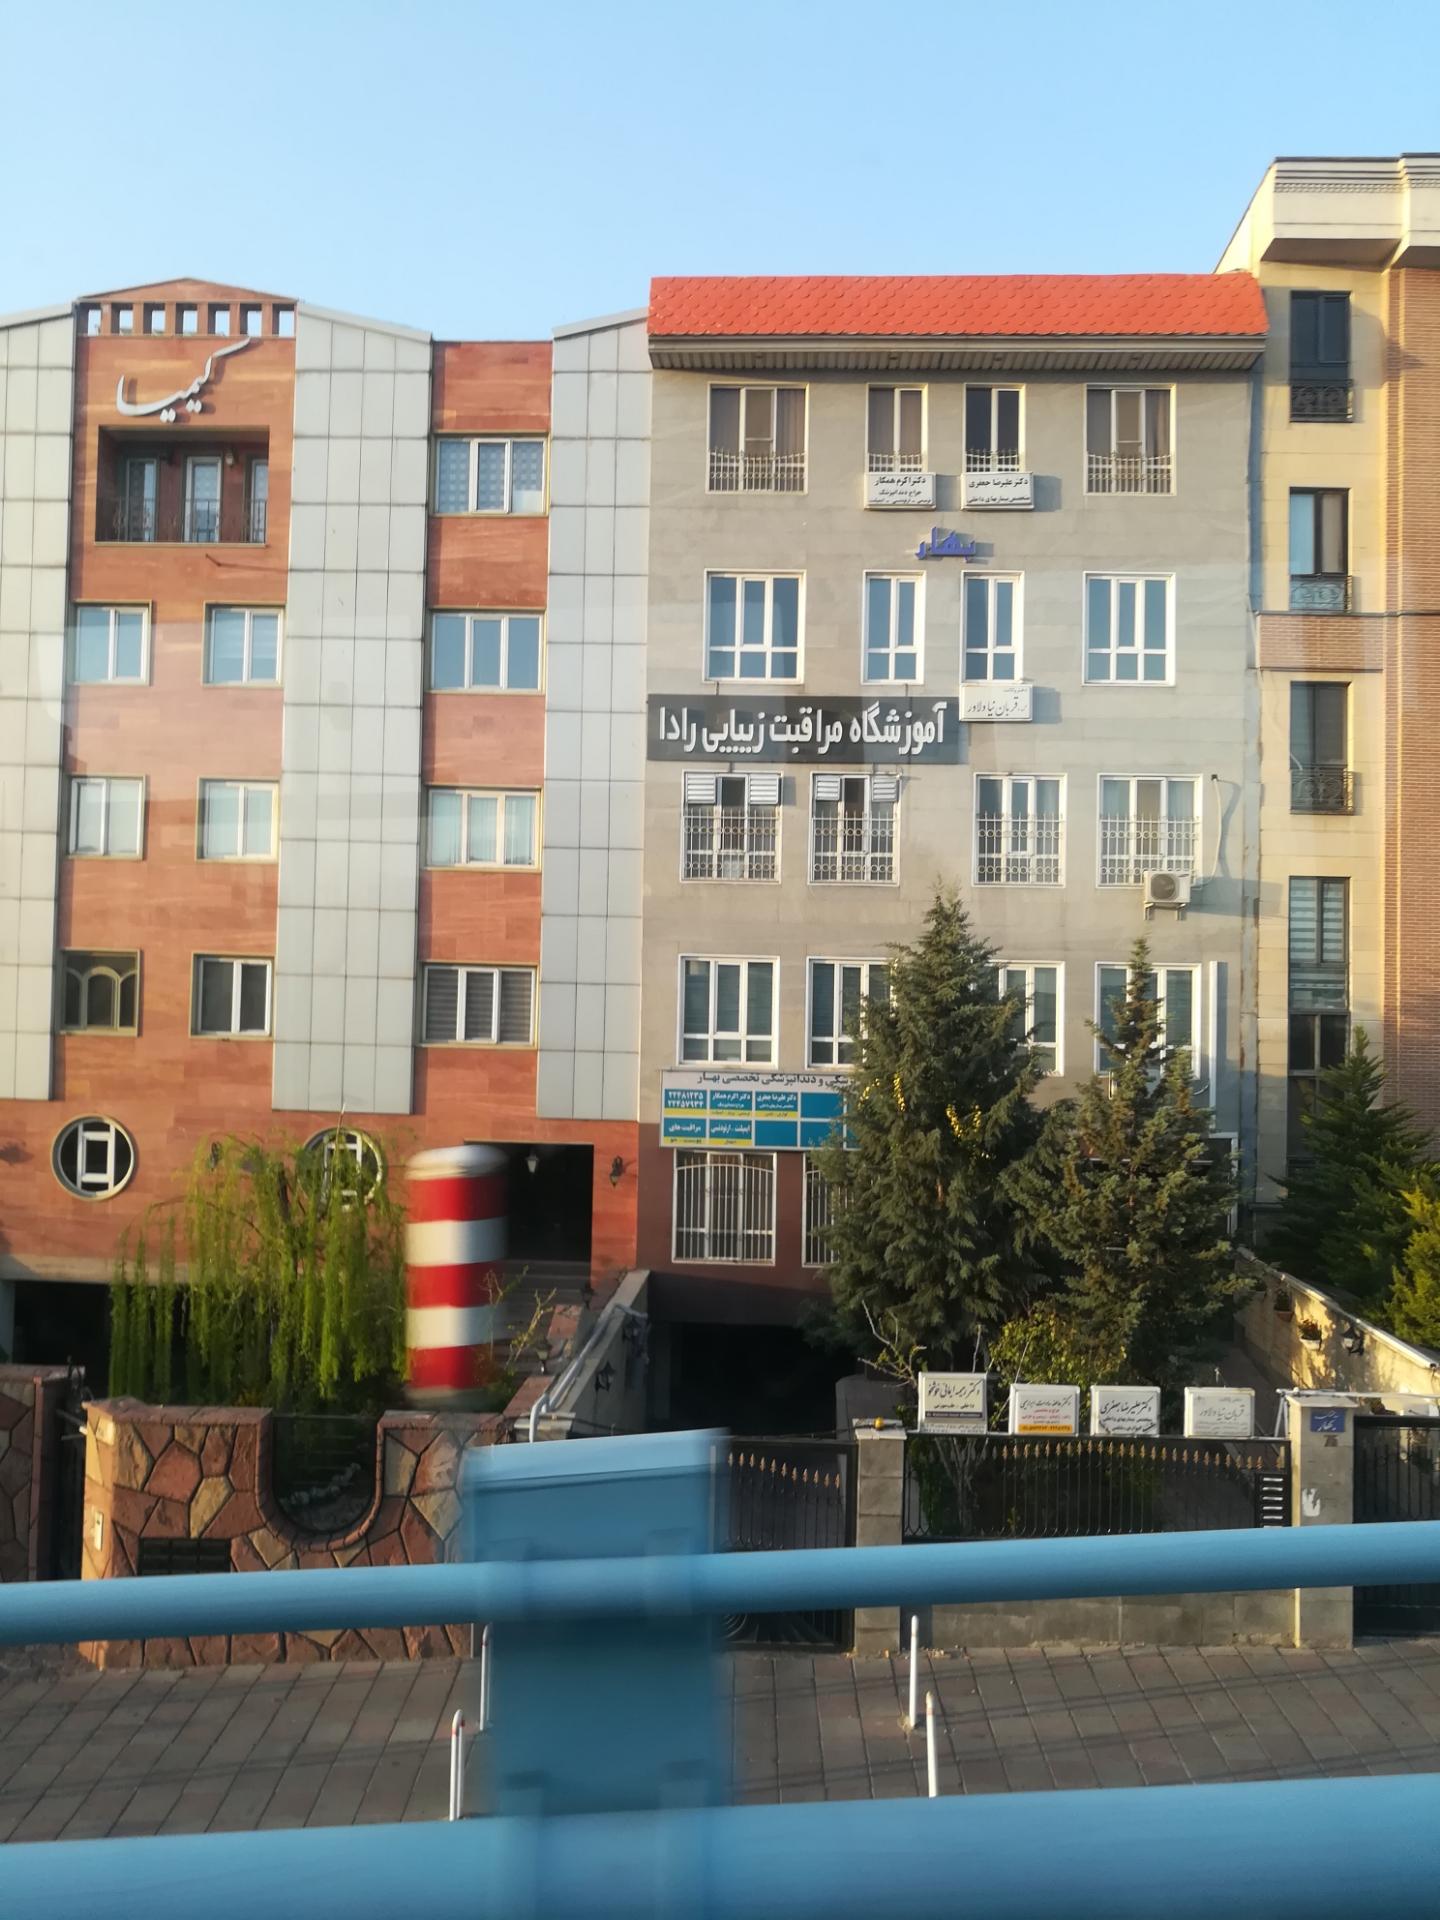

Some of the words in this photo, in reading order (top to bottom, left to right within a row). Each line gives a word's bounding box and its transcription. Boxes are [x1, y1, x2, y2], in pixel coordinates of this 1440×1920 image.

[116, 336, 251, 423] کیمیا
[1013, 477, 1029, 487] دکتر
[915, 526, 976, 564] بهار
[659, 706, 697, 753] رادا
[701, 708, 766, 754] زیبایی
[769, 706, 843, 755] مراقبت
[849, 701, 948, 756] آموزشگاه
[761, 1073, 817, 1087] دندانپزشکی
